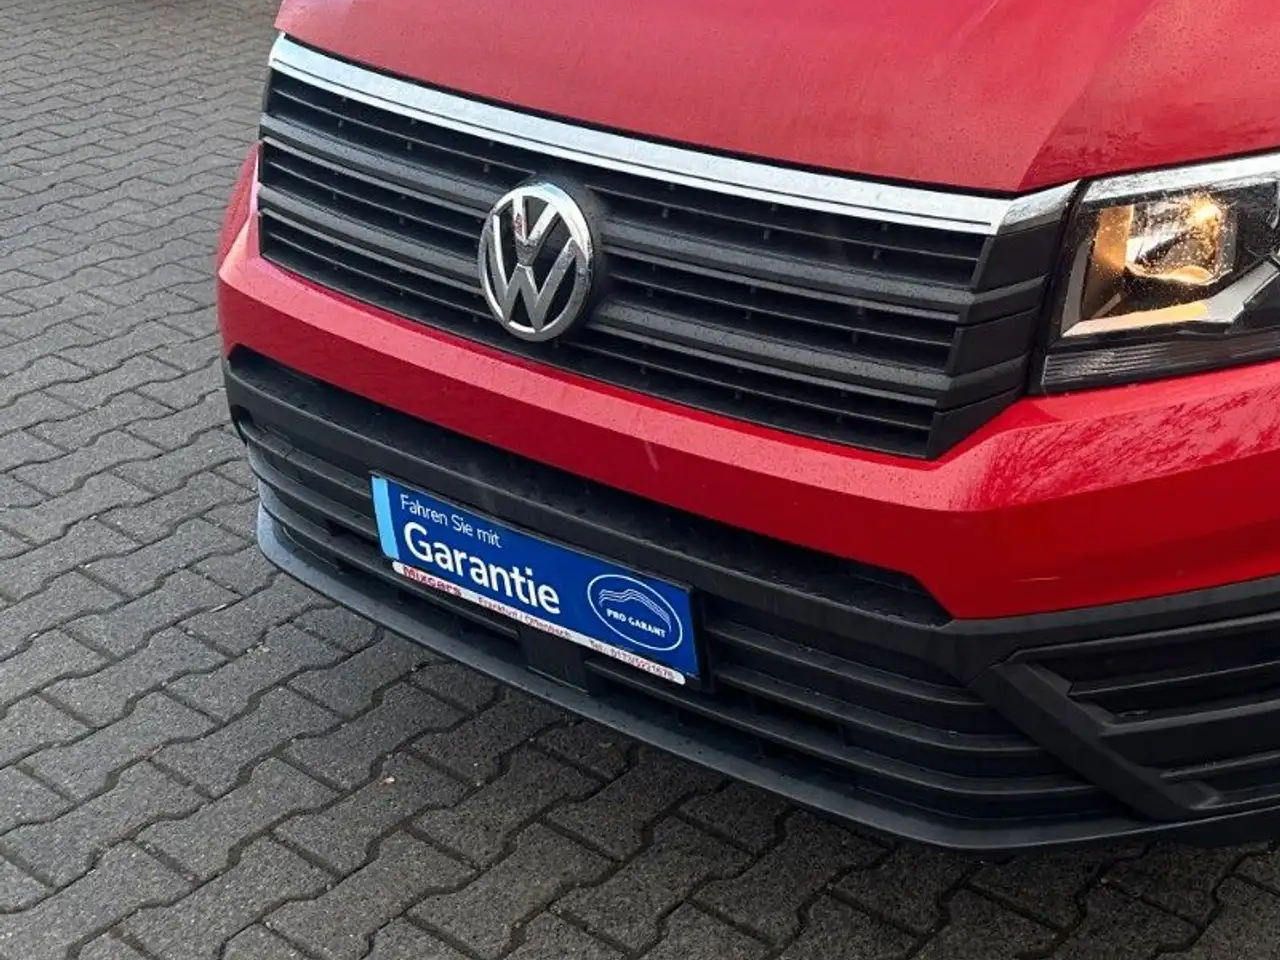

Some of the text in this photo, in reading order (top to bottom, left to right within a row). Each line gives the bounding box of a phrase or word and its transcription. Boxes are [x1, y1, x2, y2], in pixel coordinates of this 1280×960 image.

[400, 494, 502, 548] Fahren Sie mit
[404, 521, 561, 615] Garantie
[606, 607, 666, 638] PRO GARANT
